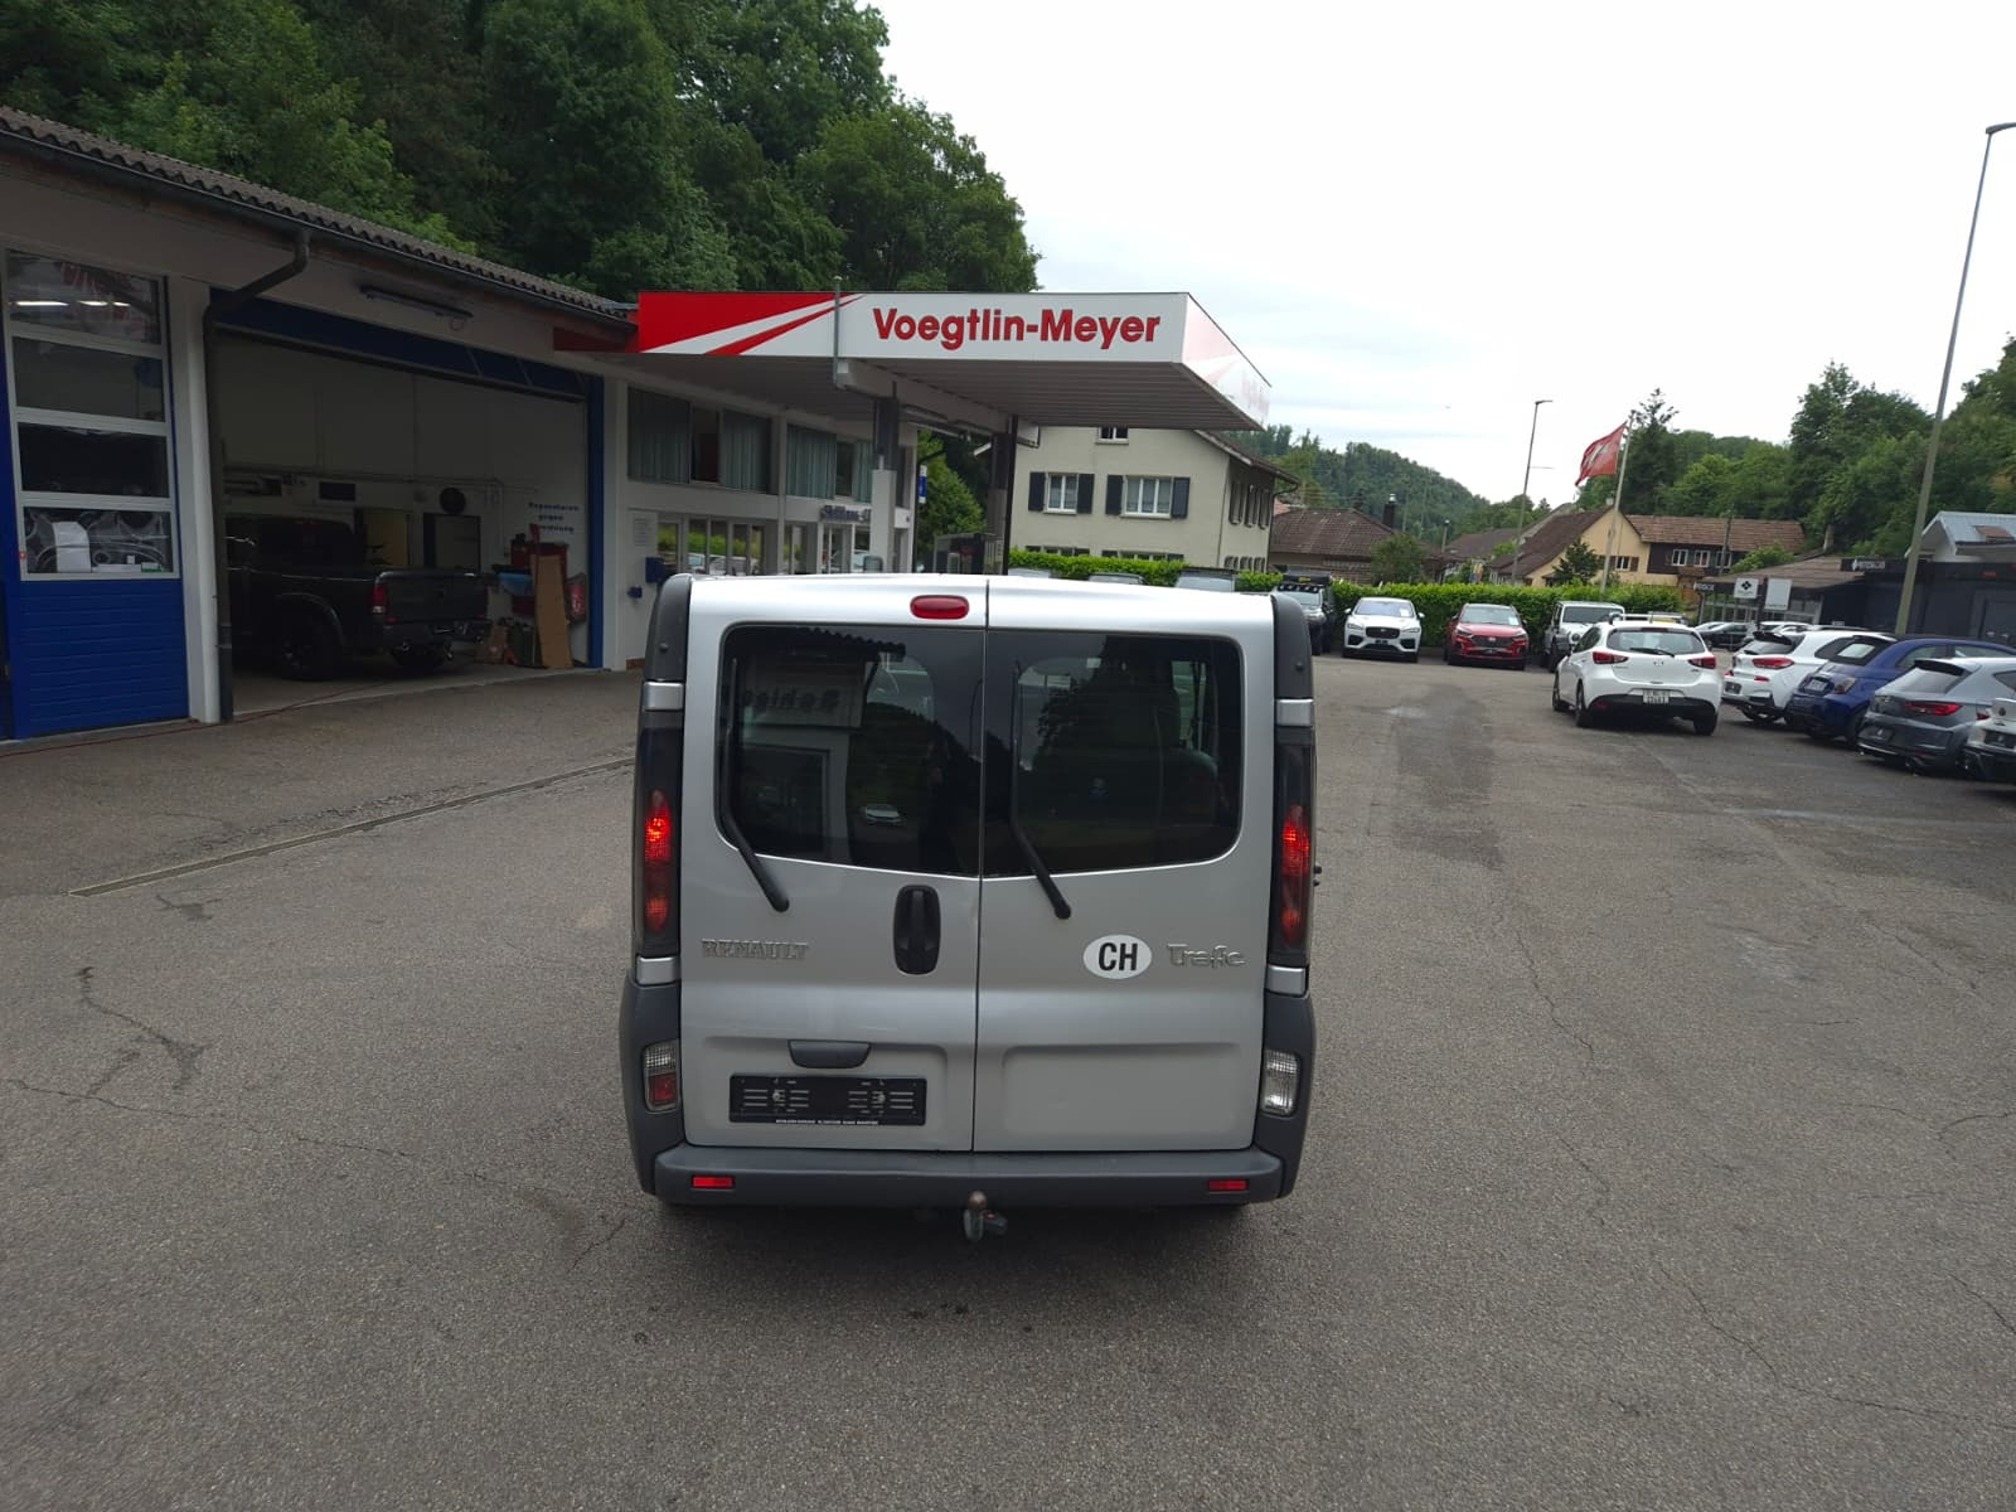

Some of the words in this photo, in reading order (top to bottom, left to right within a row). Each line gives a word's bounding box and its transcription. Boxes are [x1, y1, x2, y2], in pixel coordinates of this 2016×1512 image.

[873, 308, 1160, 350] Voegtlin-Meyer
[701, 938, 808, 960] RENAULT
[1098, 942, 1138, 971] CH
